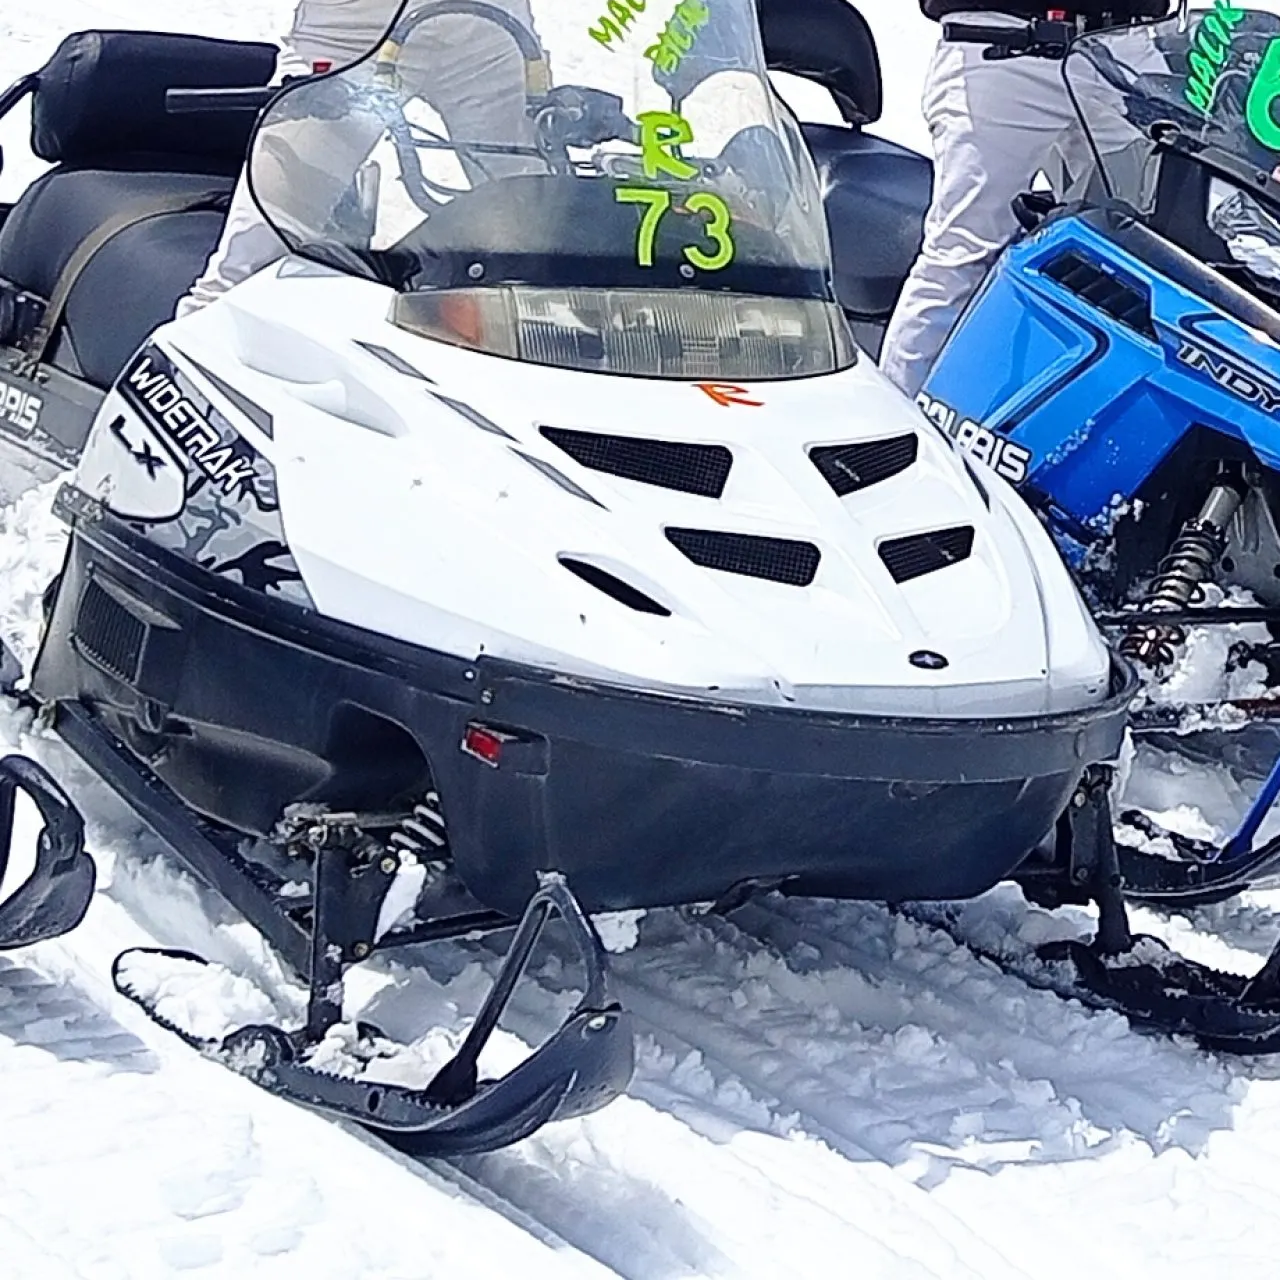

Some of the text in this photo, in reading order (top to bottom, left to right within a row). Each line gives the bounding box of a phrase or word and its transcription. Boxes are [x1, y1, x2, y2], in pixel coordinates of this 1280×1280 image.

[636, 111, 699, 180] R
[615, 187, 735, 271] 73
[110, 414, 168, 481] LX
[129, 358, 254, 493] WIDETRAK
